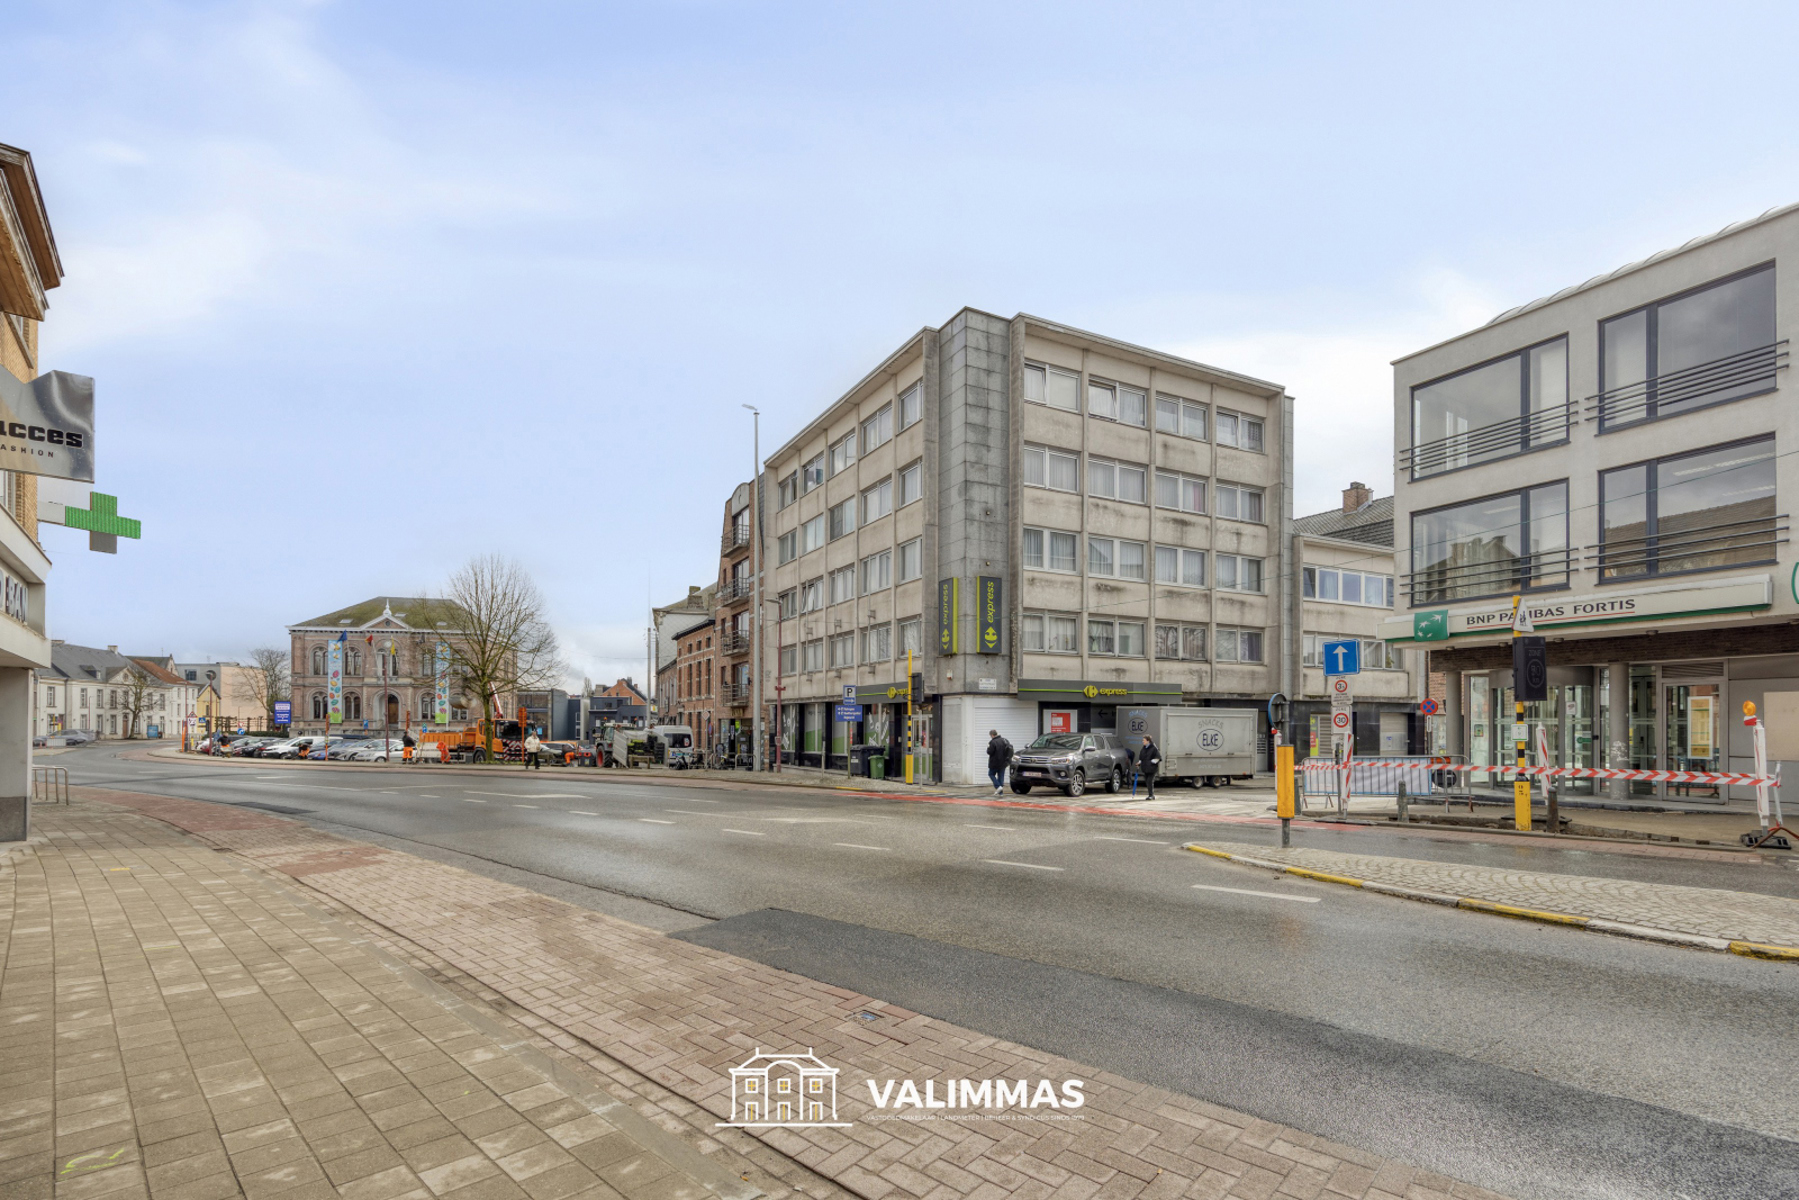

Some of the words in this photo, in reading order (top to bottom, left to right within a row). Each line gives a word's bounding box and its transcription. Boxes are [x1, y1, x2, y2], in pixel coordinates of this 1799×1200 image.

[986, 581, 996, 623] express
[1466, 614, 1496, 625] BNP
[1499, 606, 1565, 622] PAIBAS
[1573, 599, 1636, 614] FORTIS
[847, 687, 853, 697] P
[1099, 688, 1128, 696] express
[1198, 719, 1224, 729] SNACKS
[1336, 716, 1347, 724] 30
[1202, 733, 1219, 747] ELKE
